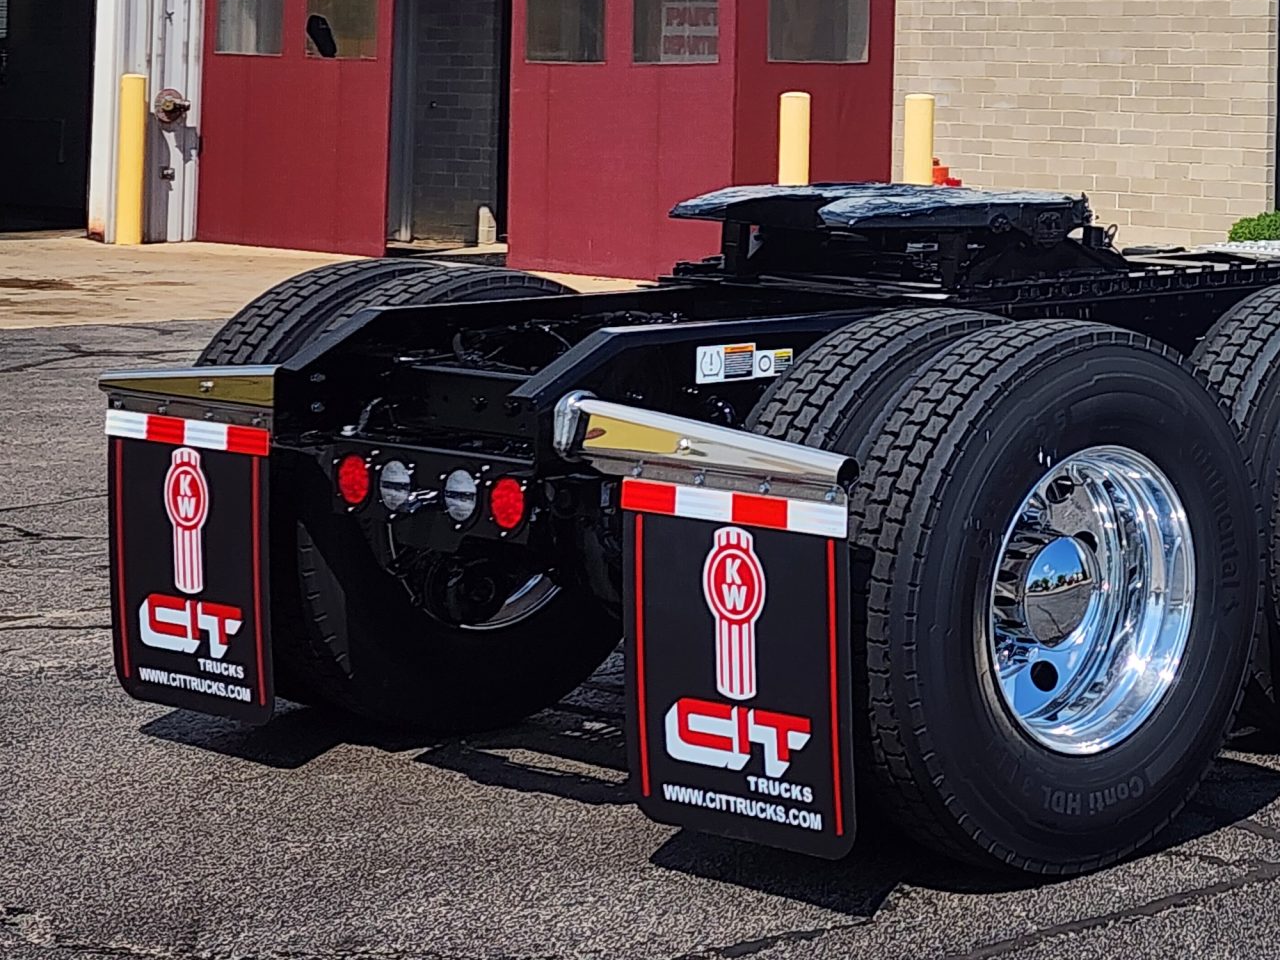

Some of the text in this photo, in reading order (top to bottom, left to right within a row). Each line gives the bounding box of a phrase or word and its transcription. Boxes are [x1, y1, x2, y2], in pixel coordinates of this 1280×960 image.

[139, 593, 243, 658] CIT
[138, 666, 252, 704] WWW.CITTRUCKS.COM
[197, 657, 245, 680] TRUCKS
[664, 697, 812, 778] CIT
[662, 783, 823, 832] WWW.CITTRUCKS.COM
[747, 775, 814, 803] TRUCKS
[1088, 776, 1145, 816] Conti
